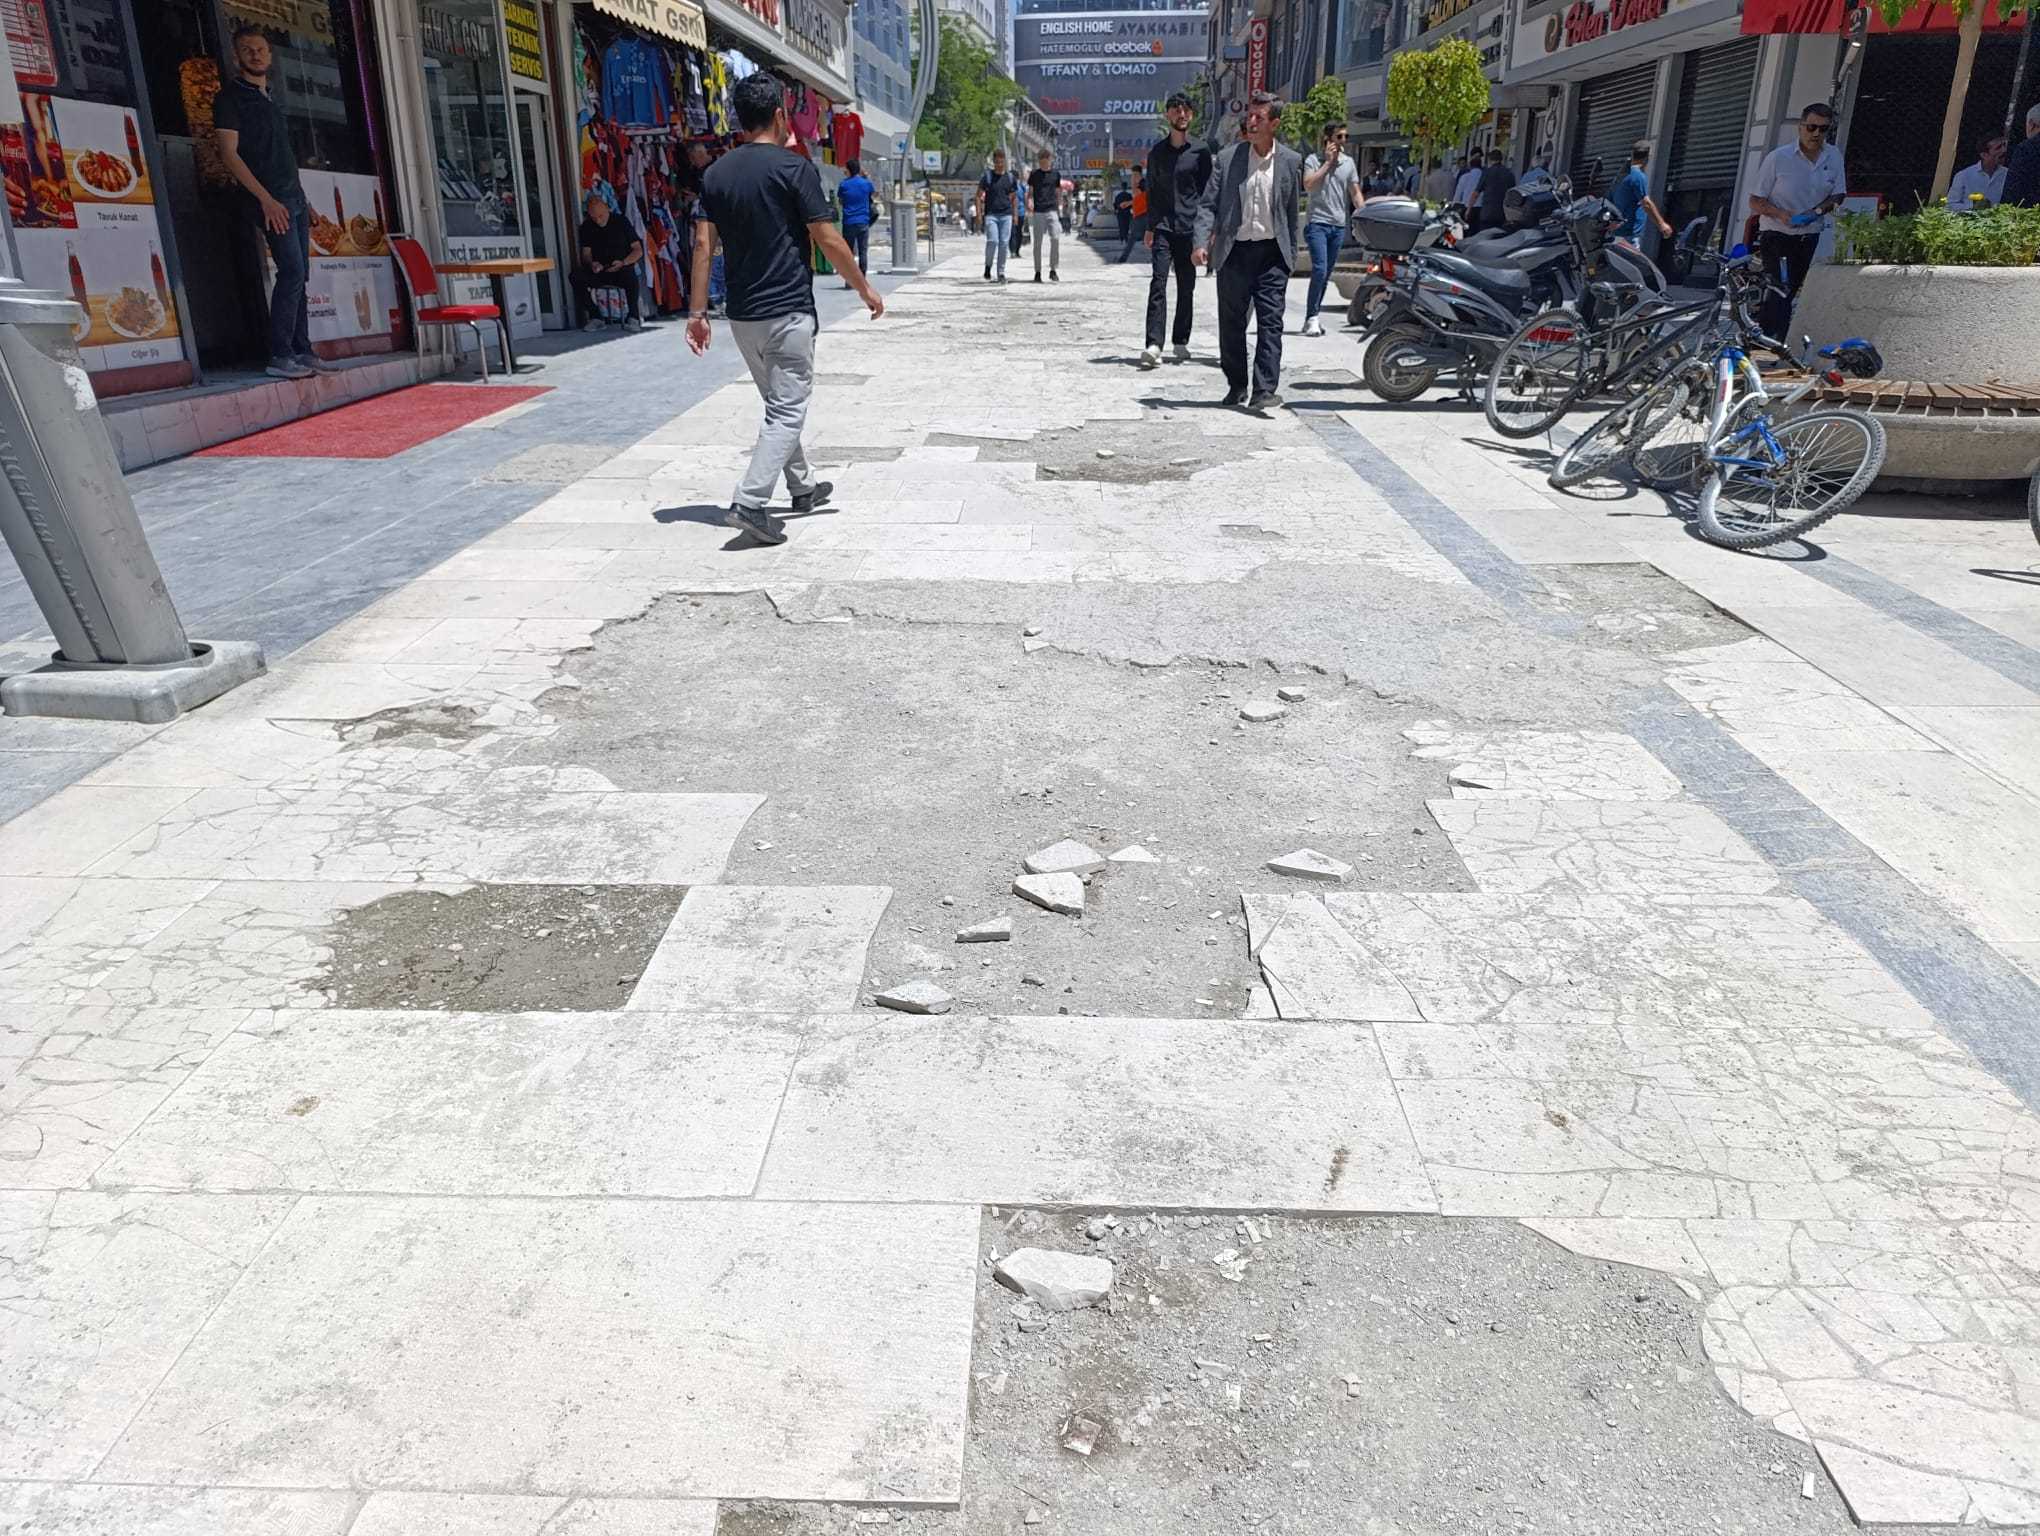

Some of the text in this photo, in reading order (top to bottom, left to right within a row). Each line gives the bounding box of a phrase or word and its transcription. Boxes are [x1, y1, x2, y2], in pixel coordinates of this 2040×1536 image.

[665, 7, 705, 41] GSM
[1040, 21, 1083, 35] ENGLISH
[1084, 20, 1114, 33] HOME
[1118, 21, 1195, 37] AYAKKABI
[1104, 40, 1152, 54] ebebek
[1040, 63, 1157, 77] TIFFANY & TOMATO
[481, 246, 520, 260] TELEFON
